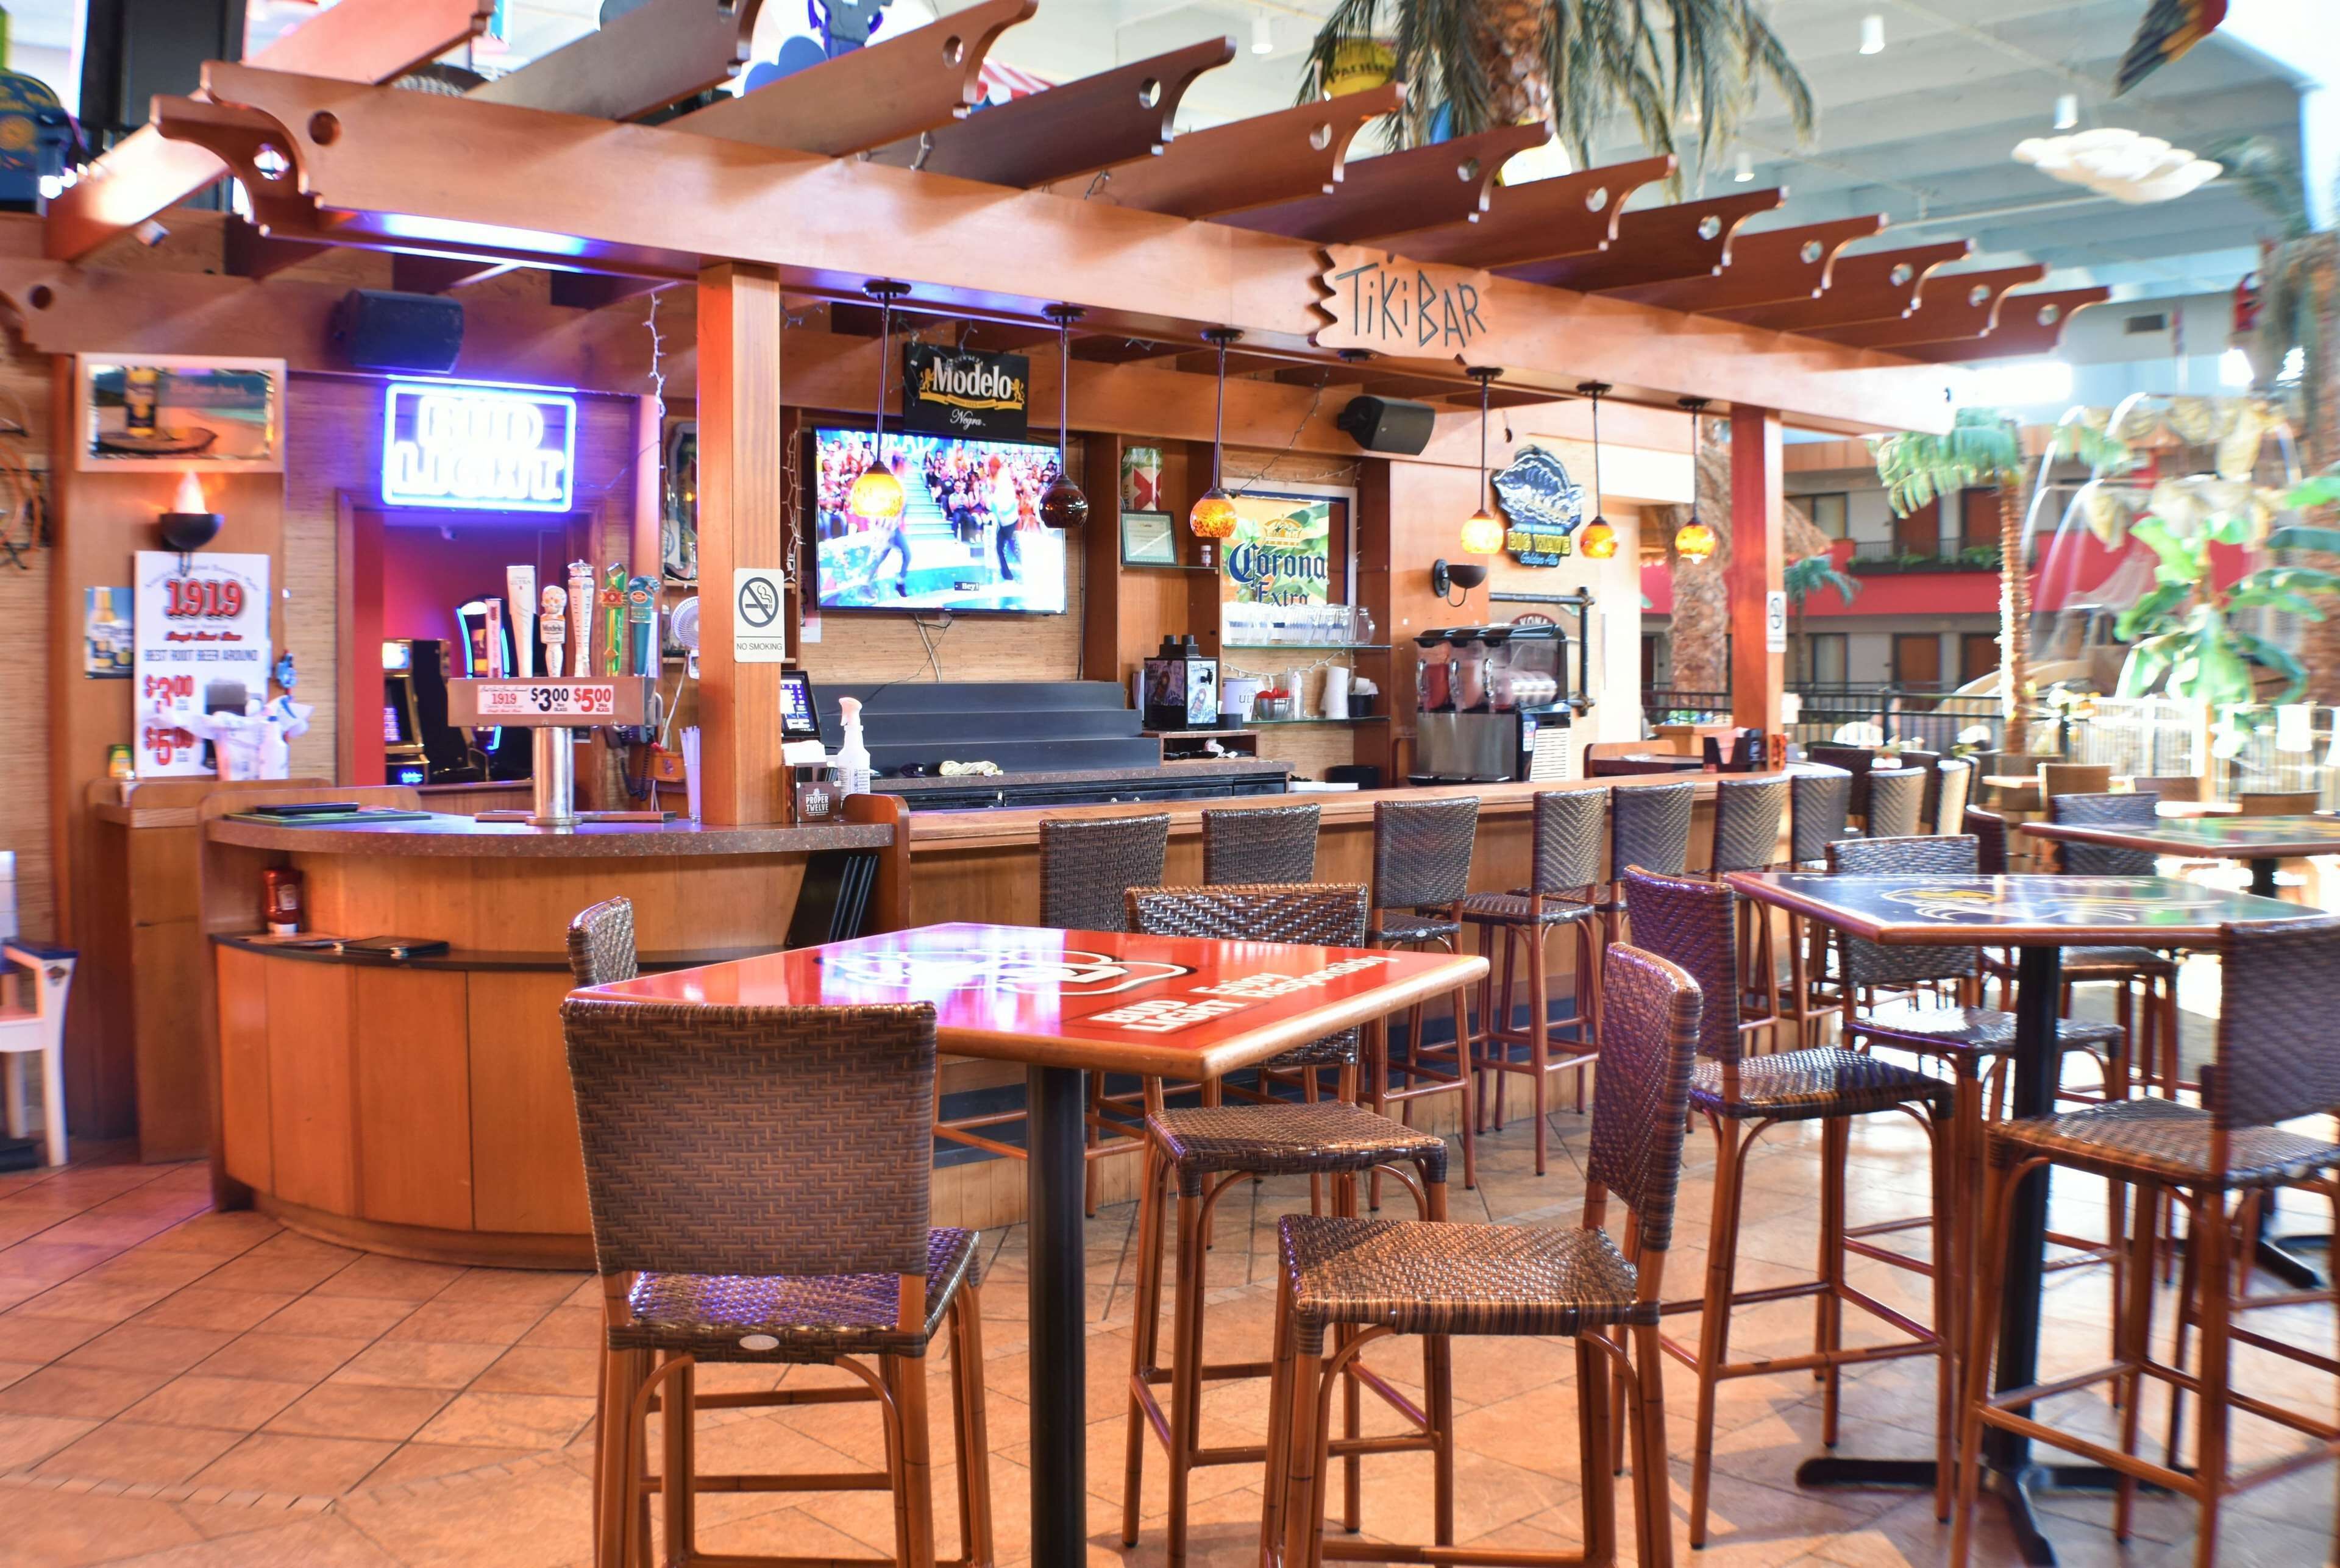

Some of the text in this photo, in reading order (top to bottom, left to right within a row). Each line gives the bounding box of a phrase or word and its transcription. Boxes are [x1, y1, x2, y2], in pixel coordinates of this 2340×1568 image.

[1418, 269, 1487, 347] BAR
[933, 357, 1012, 400] Modelo
[950, 408, 982, 430] Negra
[1228, 542, 1327, 587] Corona
[165, 579, 246, 620] 1919
[1257, 581, 1309, 606] Extra
[144, 650, 258, 662] BEST ROOT BEER AROUND
[749, 642, 783, 651] SMOKING
[492, 693, 517, 704] 1919
[806, 795, 829, 804] PROPER
[1189, 973, 1294, 994] Enjoy
[1236, 955, 1399, 998] Responsibly
[1089, 999, 1188, 1023] BUD
[1121, 999, 1248, 1032] LIGHT
